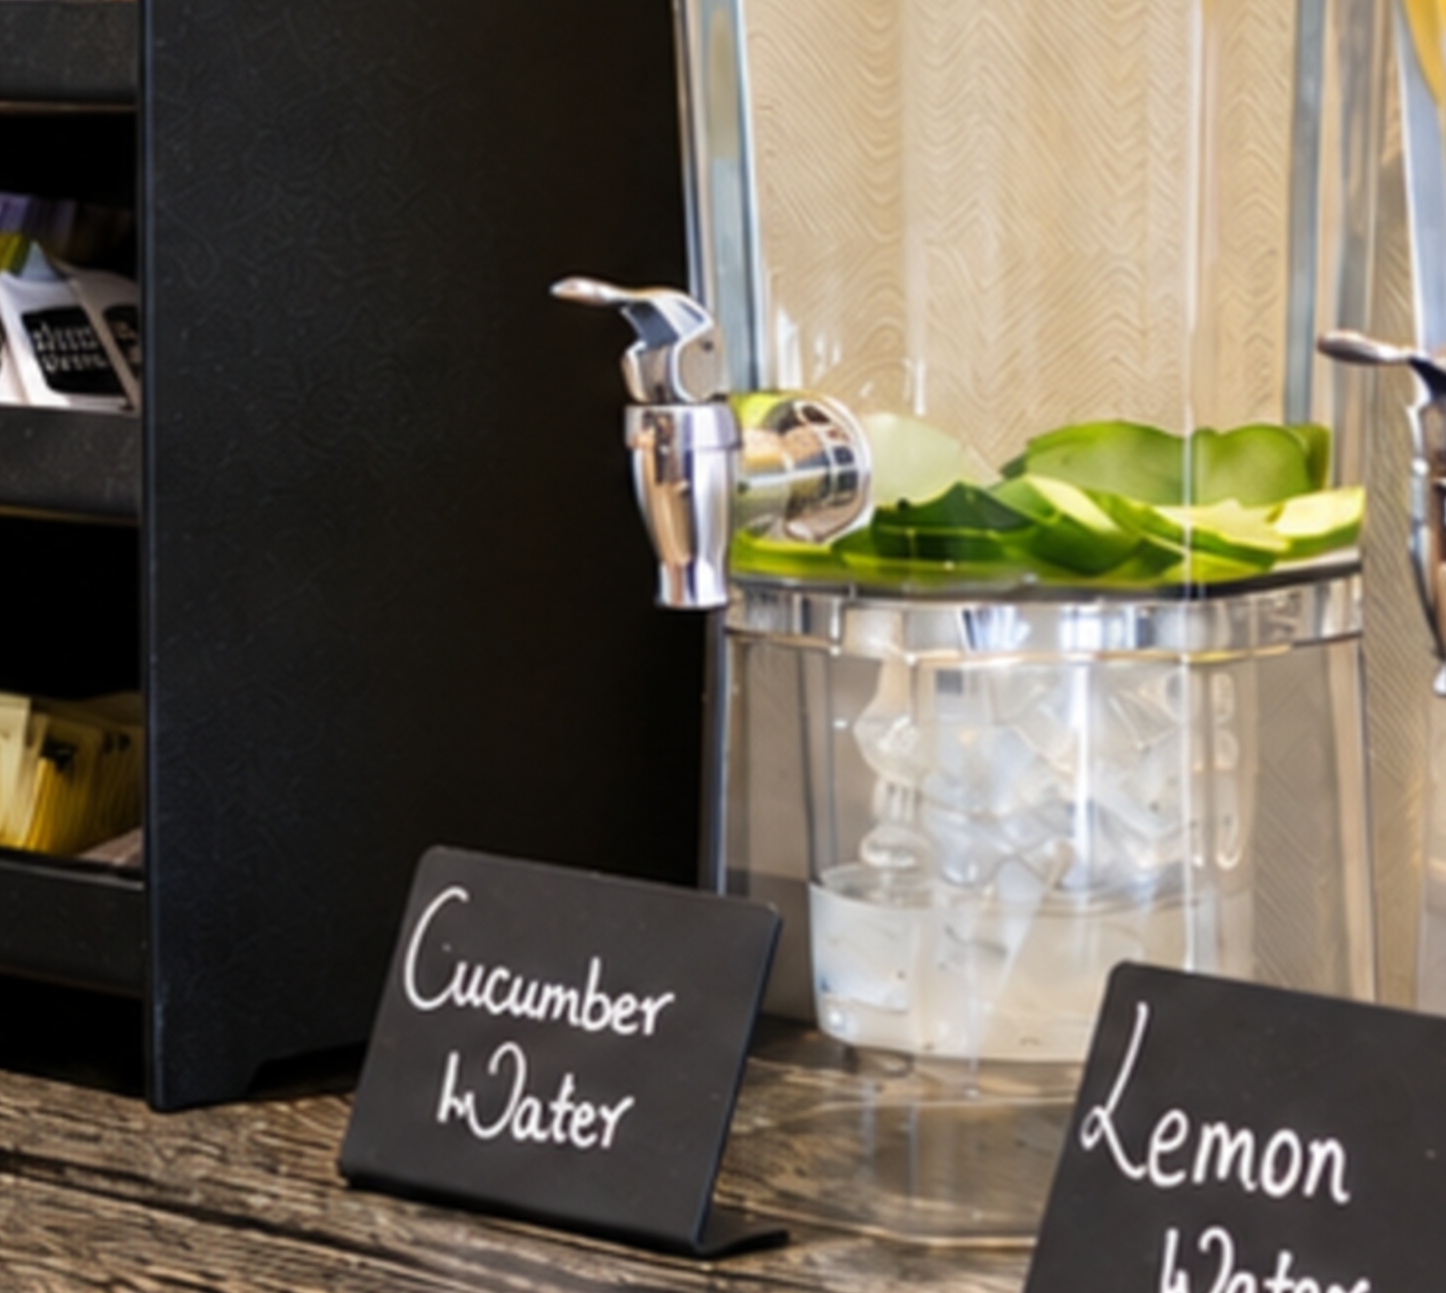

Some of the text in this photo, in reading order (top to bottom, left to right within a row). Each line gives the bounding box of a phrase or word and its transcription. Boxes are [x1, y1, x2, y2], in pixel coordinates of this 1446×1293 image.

[403, 885, 676, 1036] Cucumber
[436, 1041, 636, 1149] Water
[1079, 1001, 1352, 1205] Lemon
